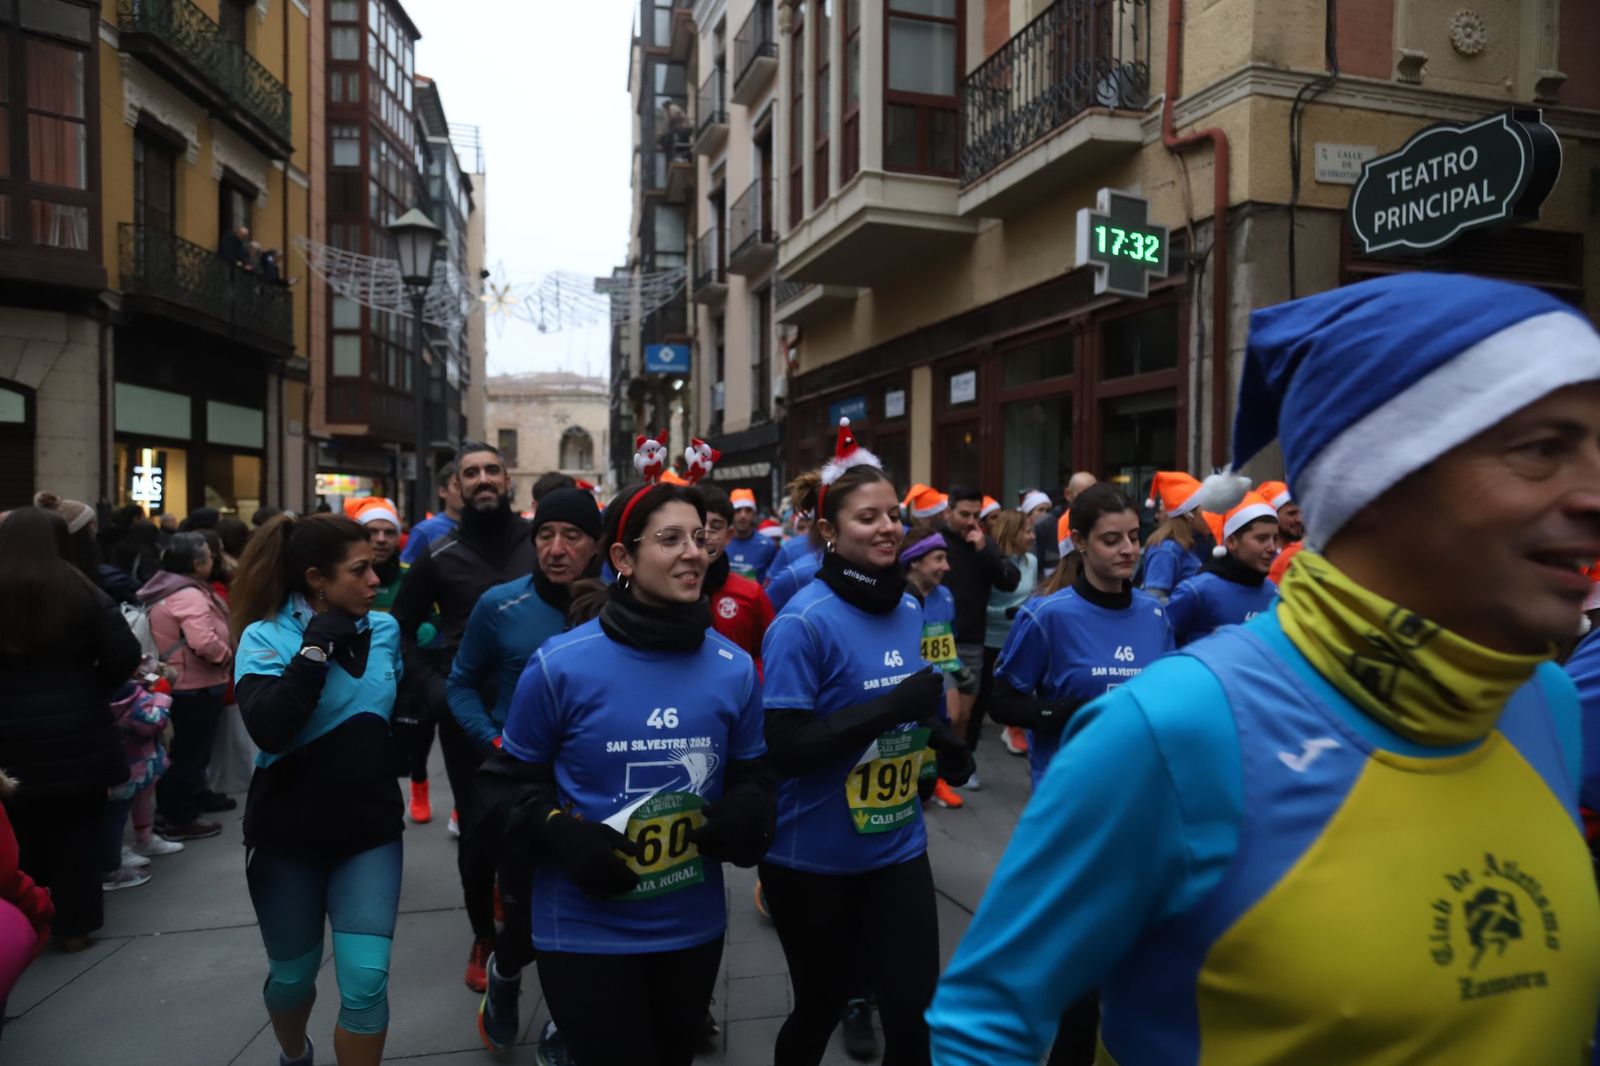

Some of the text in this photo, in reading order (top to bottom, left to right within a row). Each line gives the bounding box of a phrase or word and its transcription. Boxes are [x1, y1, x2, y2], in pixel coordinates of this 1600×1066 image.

[1337, 151, 1362, 160] CALLE
[1387, 146, 1478, 194] TEATRO
[1374, 179, 1496, 234] PRINCIPAL
[1095, 225, 1159, 263] 17:32
[884, 650, 904, 668] 46
[921, 637, 951, 659] 485
[1114, 646, 1135, 662] 46
[1091, 667, 1107, 676] SAN
[863, 679, 880, 690] SAN
[646, 707, 680, 730] 46
[606, 736, 712, 753] SAN SILVESTRE 2025
[855, 759, 912, 801] 199
[870, 814, 895, 825] CAJA
[633, 865, 698, 893] AJA RURAL
[1429, 897, 1454, 967] Club
[1457, 970, 1549, 1001] Zamora
